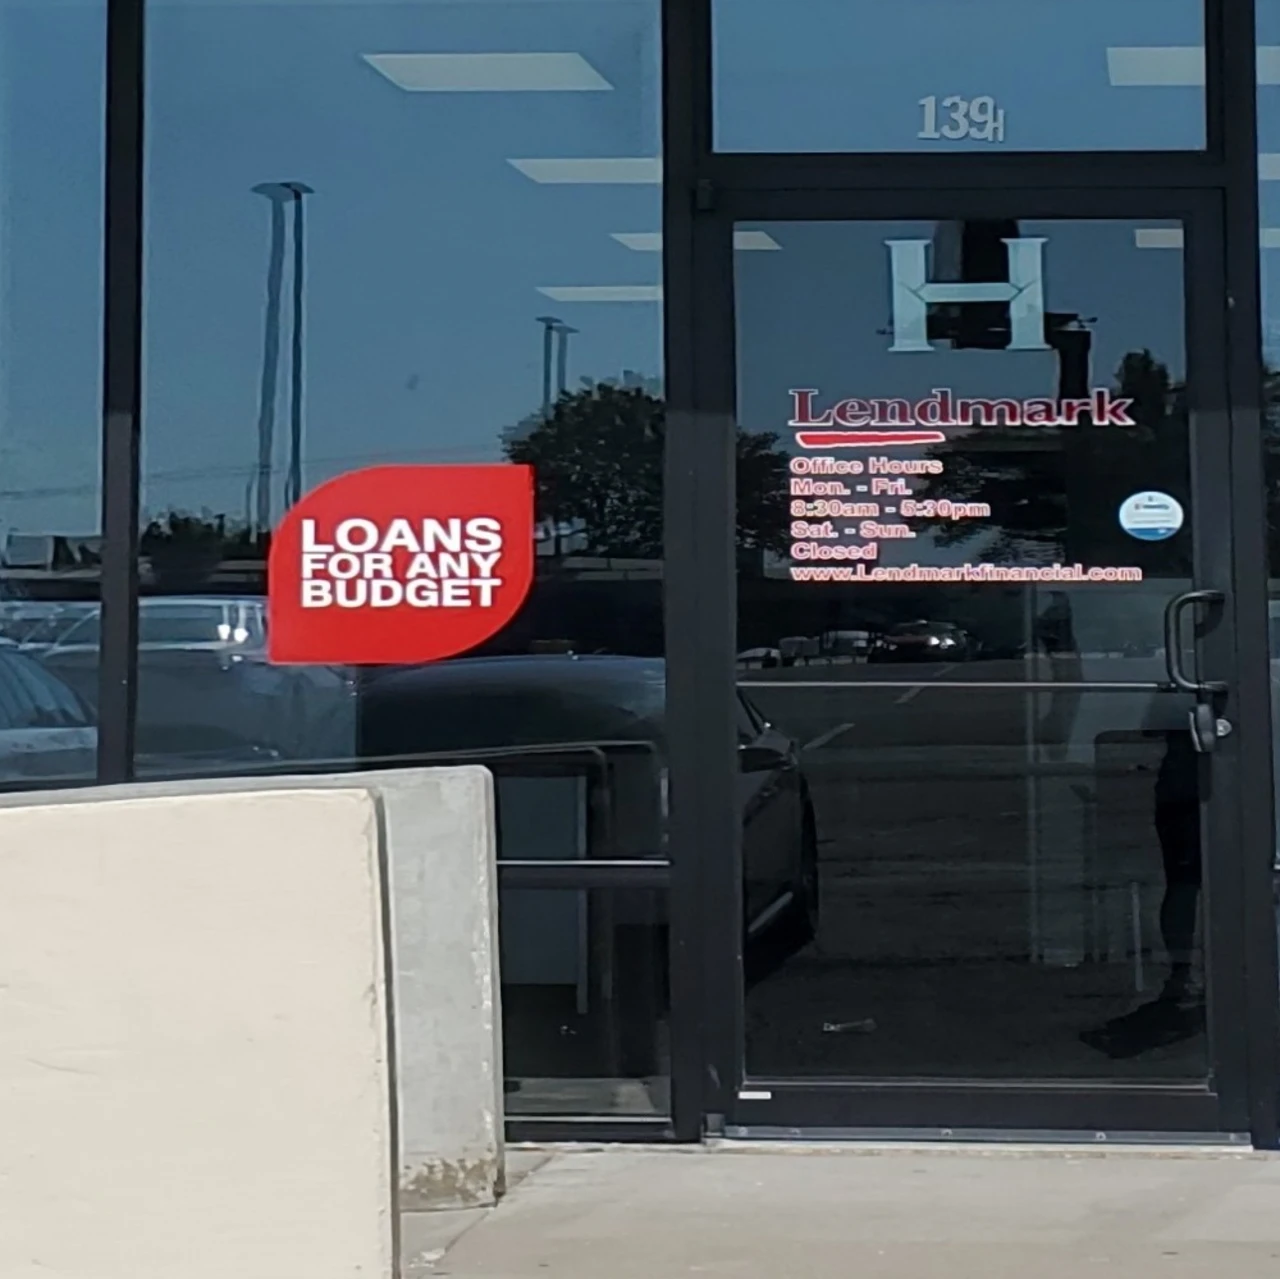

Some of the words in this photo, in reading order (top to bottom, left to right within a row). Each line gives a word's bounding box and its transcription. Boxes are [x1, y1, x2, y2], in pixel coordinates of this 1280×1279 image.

[884, 237, 1052, 352] H
[787, 388, 1136, 427] Lendmark
[789, 457, 864, 474] Office
[868, 457, 944, 474] Hours
[790, 478, 851, 495] Mon.
[871, 478, 914, 496] Fri.
[790, 499, 880, 517] 8:30am
[899, 499, 992, 521] 5:30pm
[301, 517, 503, 553] LOANS
[790, 521, 839, 538] Sat.
[859, 520, 917, 538] Sun.
[790, 542, 878, 560] Closed
[301, 552, 394, 579] FOR
[405, 552, 503, 579] ANY
[790, 563, 1142, 582] www.Lendmarkfinancial.com
[301, 578, 503, 608] BUDGET
